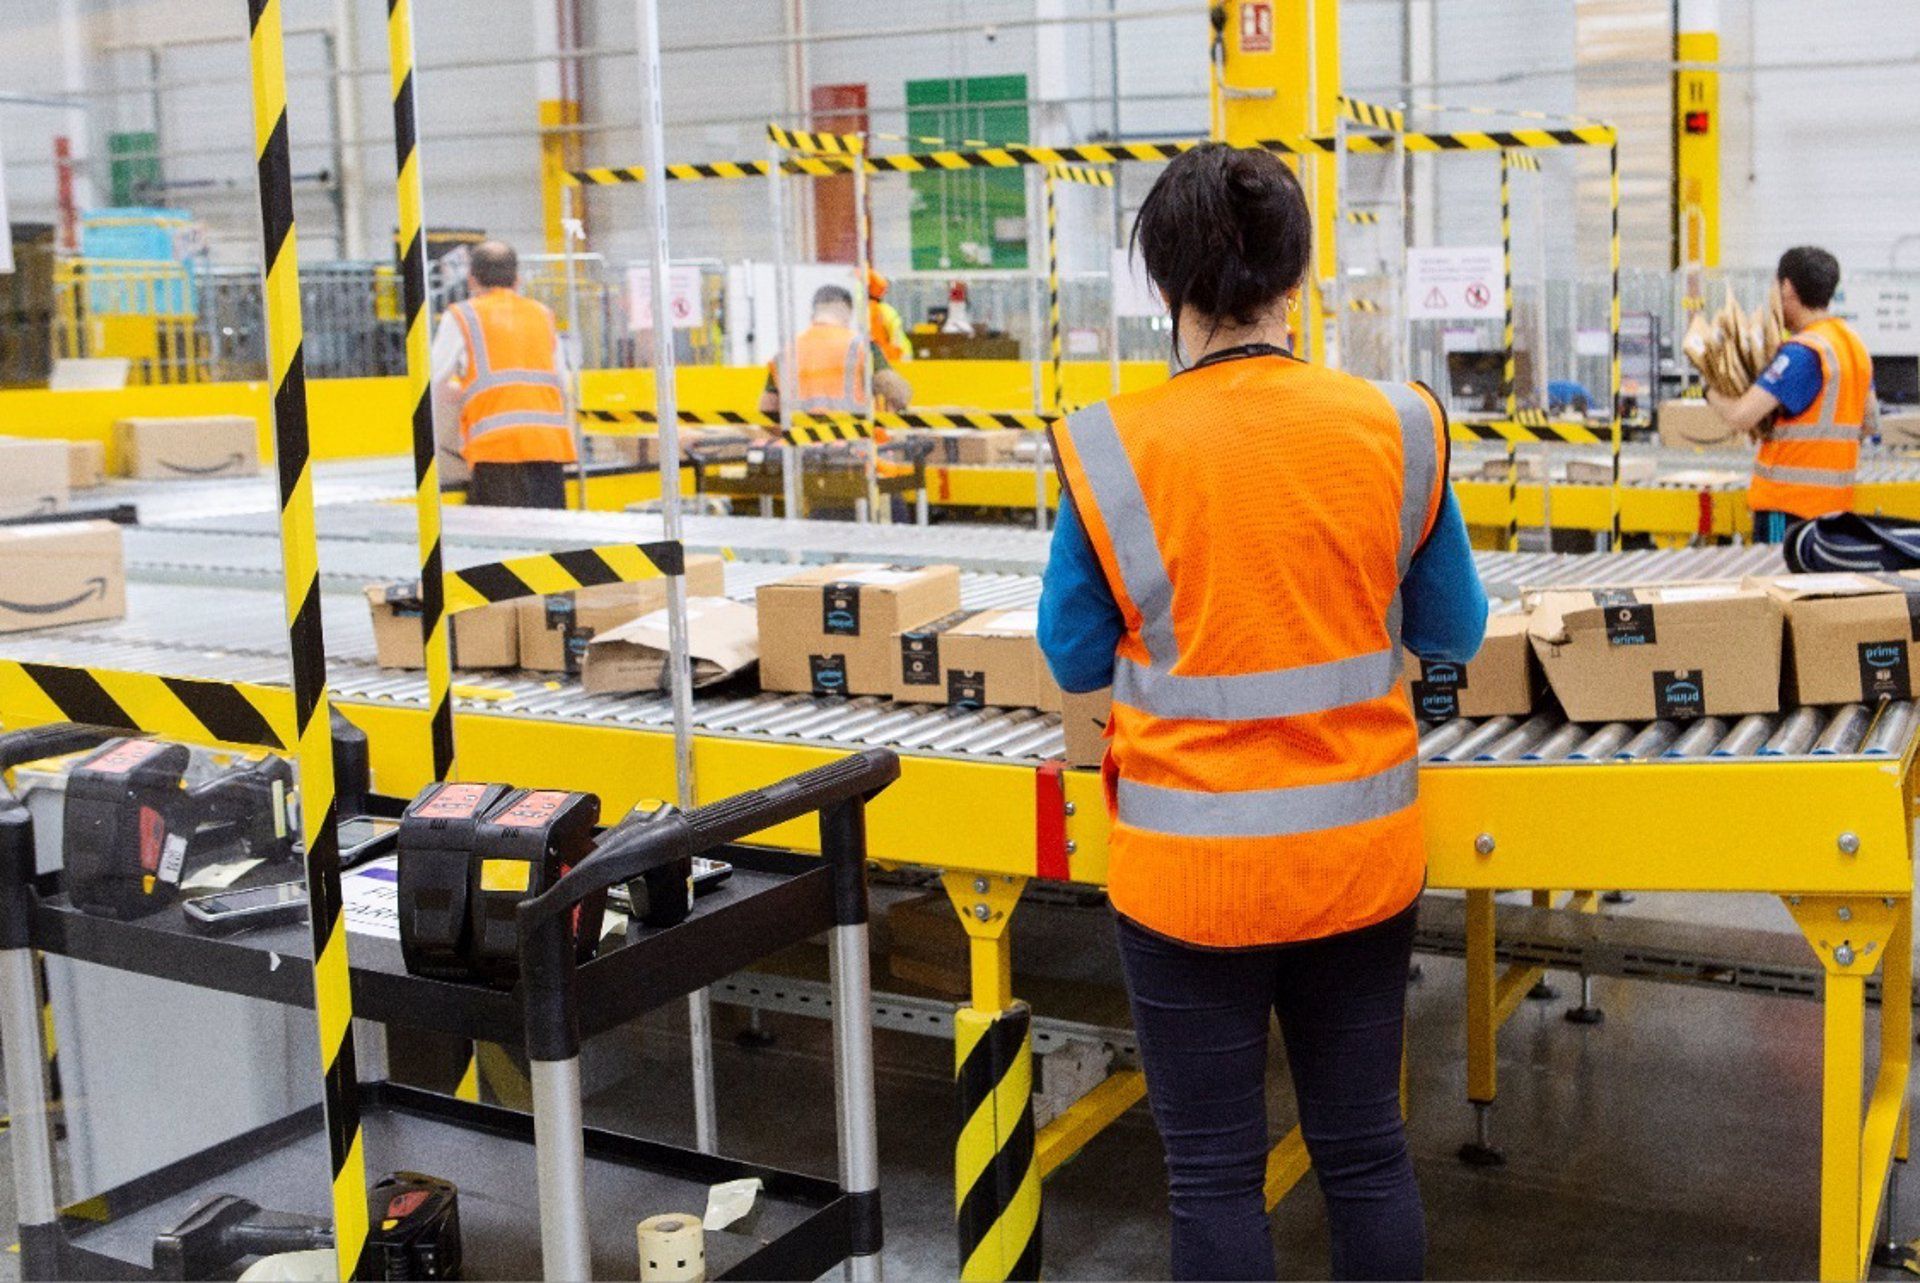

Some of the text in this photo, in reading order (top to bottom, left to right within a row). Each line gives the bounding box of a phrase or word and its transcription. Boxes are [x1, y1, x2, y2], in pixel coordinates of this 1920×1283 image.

[1865, 646, 1900, 659] prime
[1427, 670, 1459, 685] prime
[1422, 694, 1454, 708] prime
[1666, 691, 1700, 705] prime
